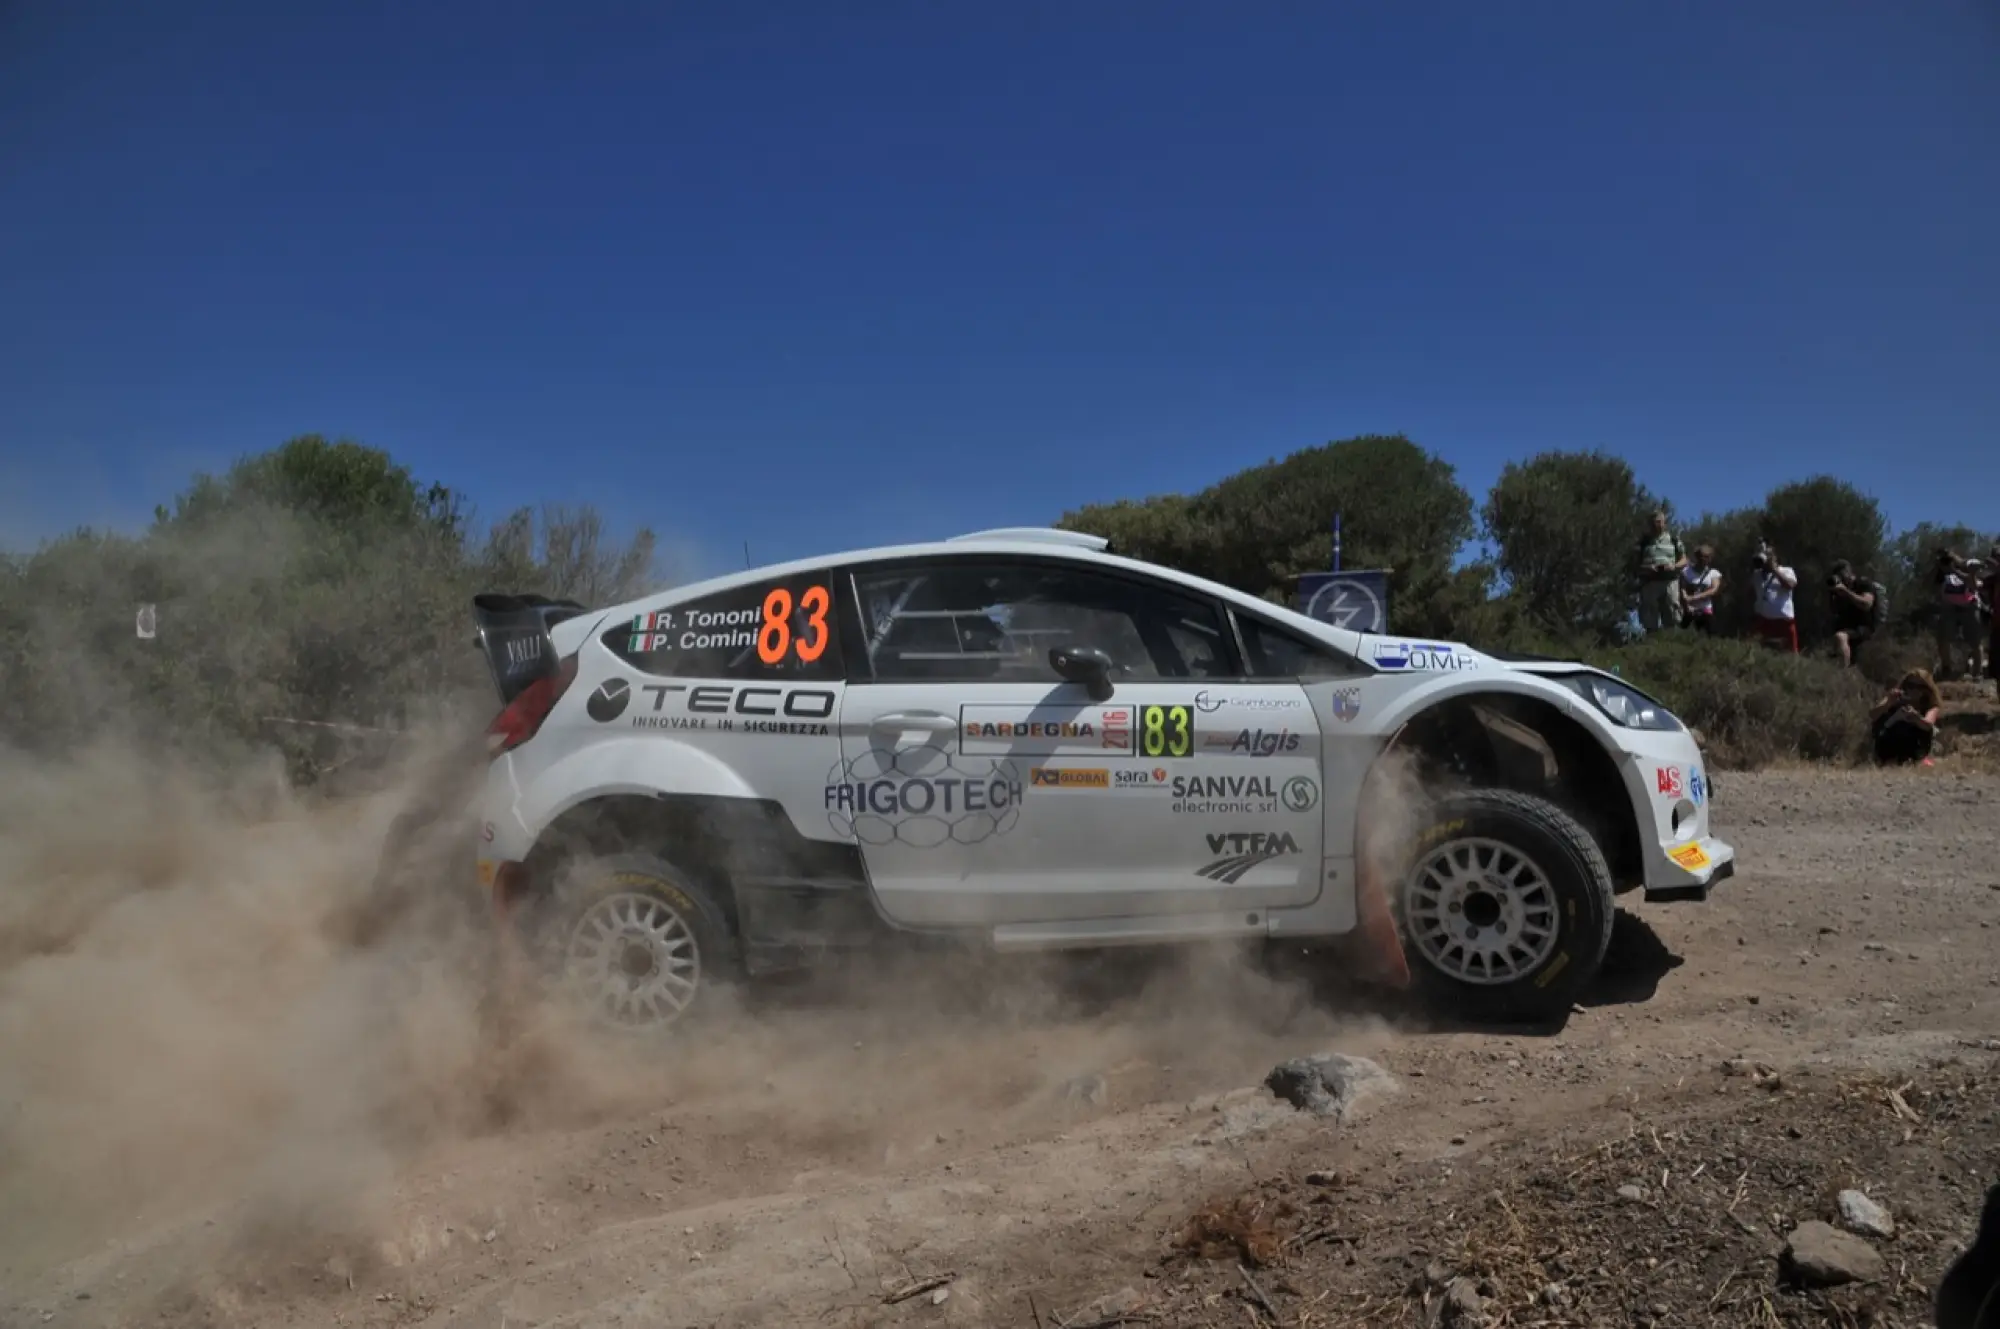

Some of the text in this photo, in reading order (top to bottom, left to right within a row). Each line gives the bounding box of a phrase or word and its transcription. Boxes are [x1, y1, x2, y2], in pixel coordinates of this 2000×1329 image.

[656, 606, 761, 630] R. Tononi
[757, 585, 830, 664] 83
[652, 628, 759, 651] P. Comini
[641, 685, 836, 718] TECO
[632, 716, 829, 736] INNOVARE IN SICUREZZA
[966, 722, 1095, 738] SARDEGNA
[1144, 704, 1190, 757] 83
[1231, 727, 1301, 759] Algis
[1060, 772, 1106, 785] GLOBAL
[1114, 769, 1149, 783] sara
[1172, 775, 1278, 798] SANVAL
[824, 778, 1023, 815] FRIGOTECH
[1172, 797, 1278, 814] electronic srl
